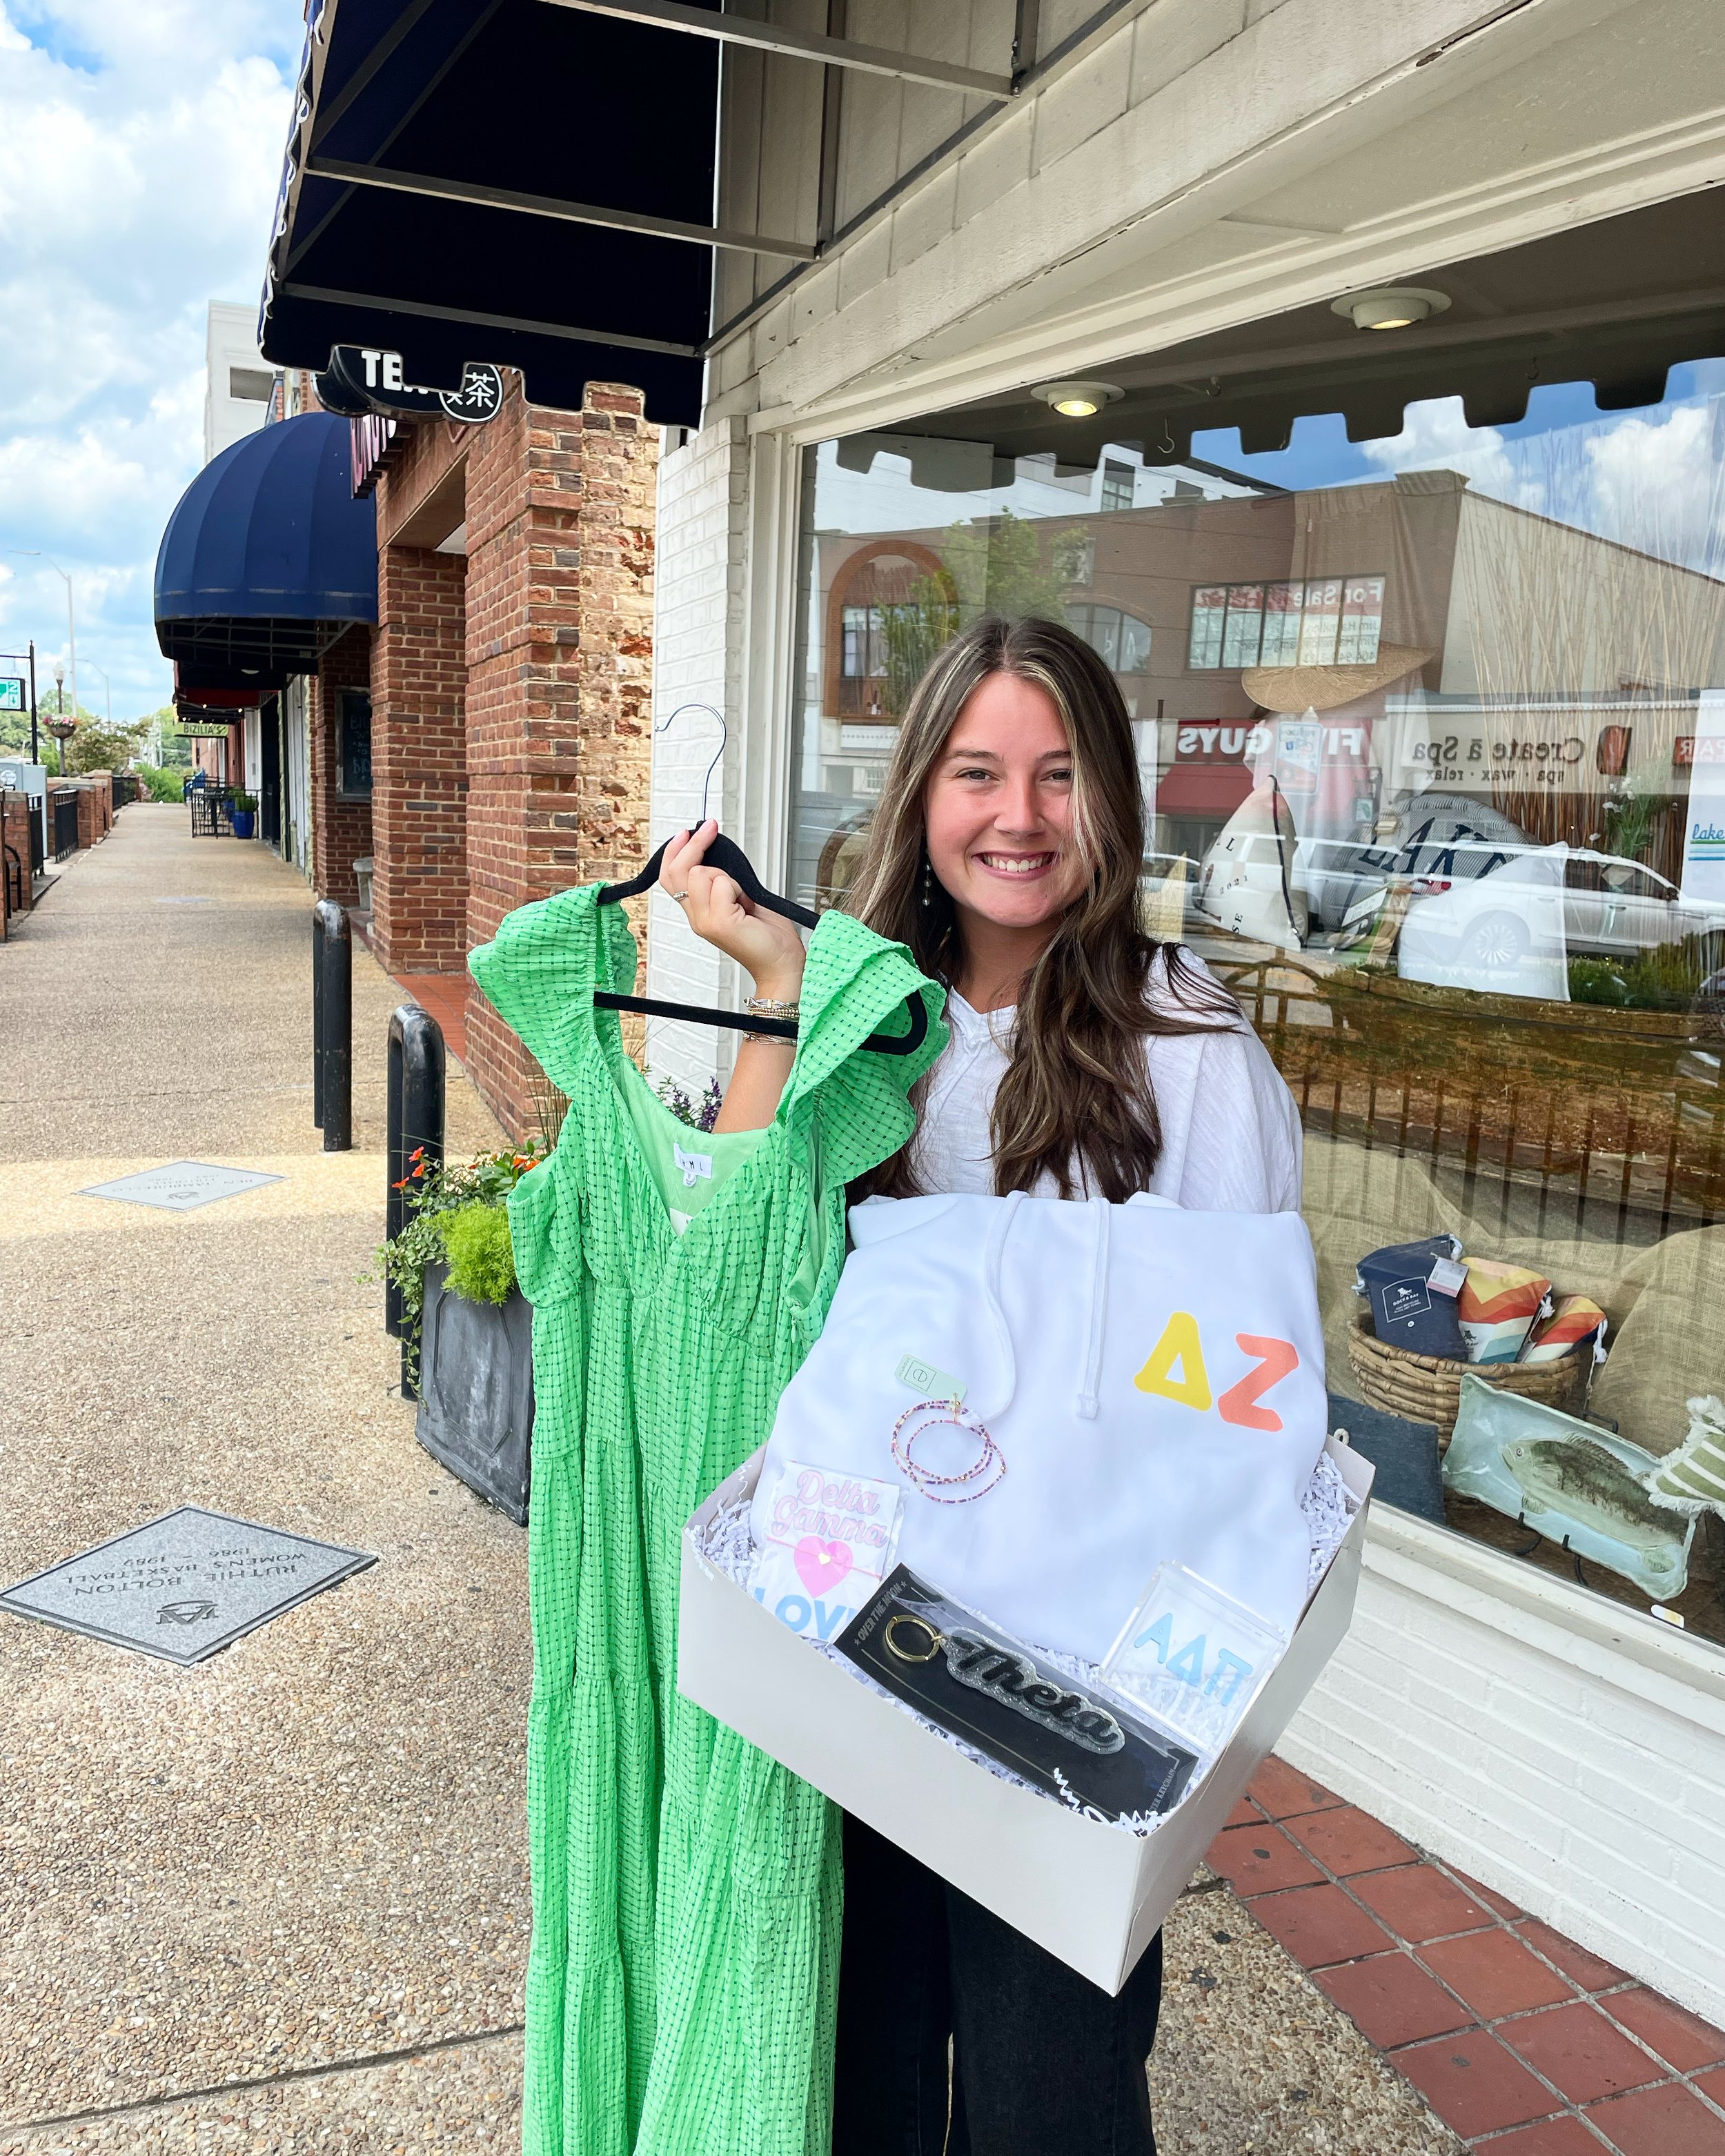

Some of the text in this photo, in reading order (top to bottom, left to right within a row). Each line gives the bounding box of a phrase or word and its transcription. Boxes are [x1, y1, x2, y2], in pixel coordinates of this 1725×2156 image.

[361, 350, 428, 395] TE
[184, 723, 221, 735] BIZILIA'S
[796, 1469, 880, 1516] Delta
[771, 1495, 889, 1548] Gamma
[62, 1563, 197, 1584] BASKETBALL
[75, 1564, 296, 1596] RUTHIE BOLTON
[858, 1582, 903, 1641] OVER THE MOON
[950, 1636, 1119, 1745] Theta
[1156, 1768, 1176, 1800] KEYCHAIN
